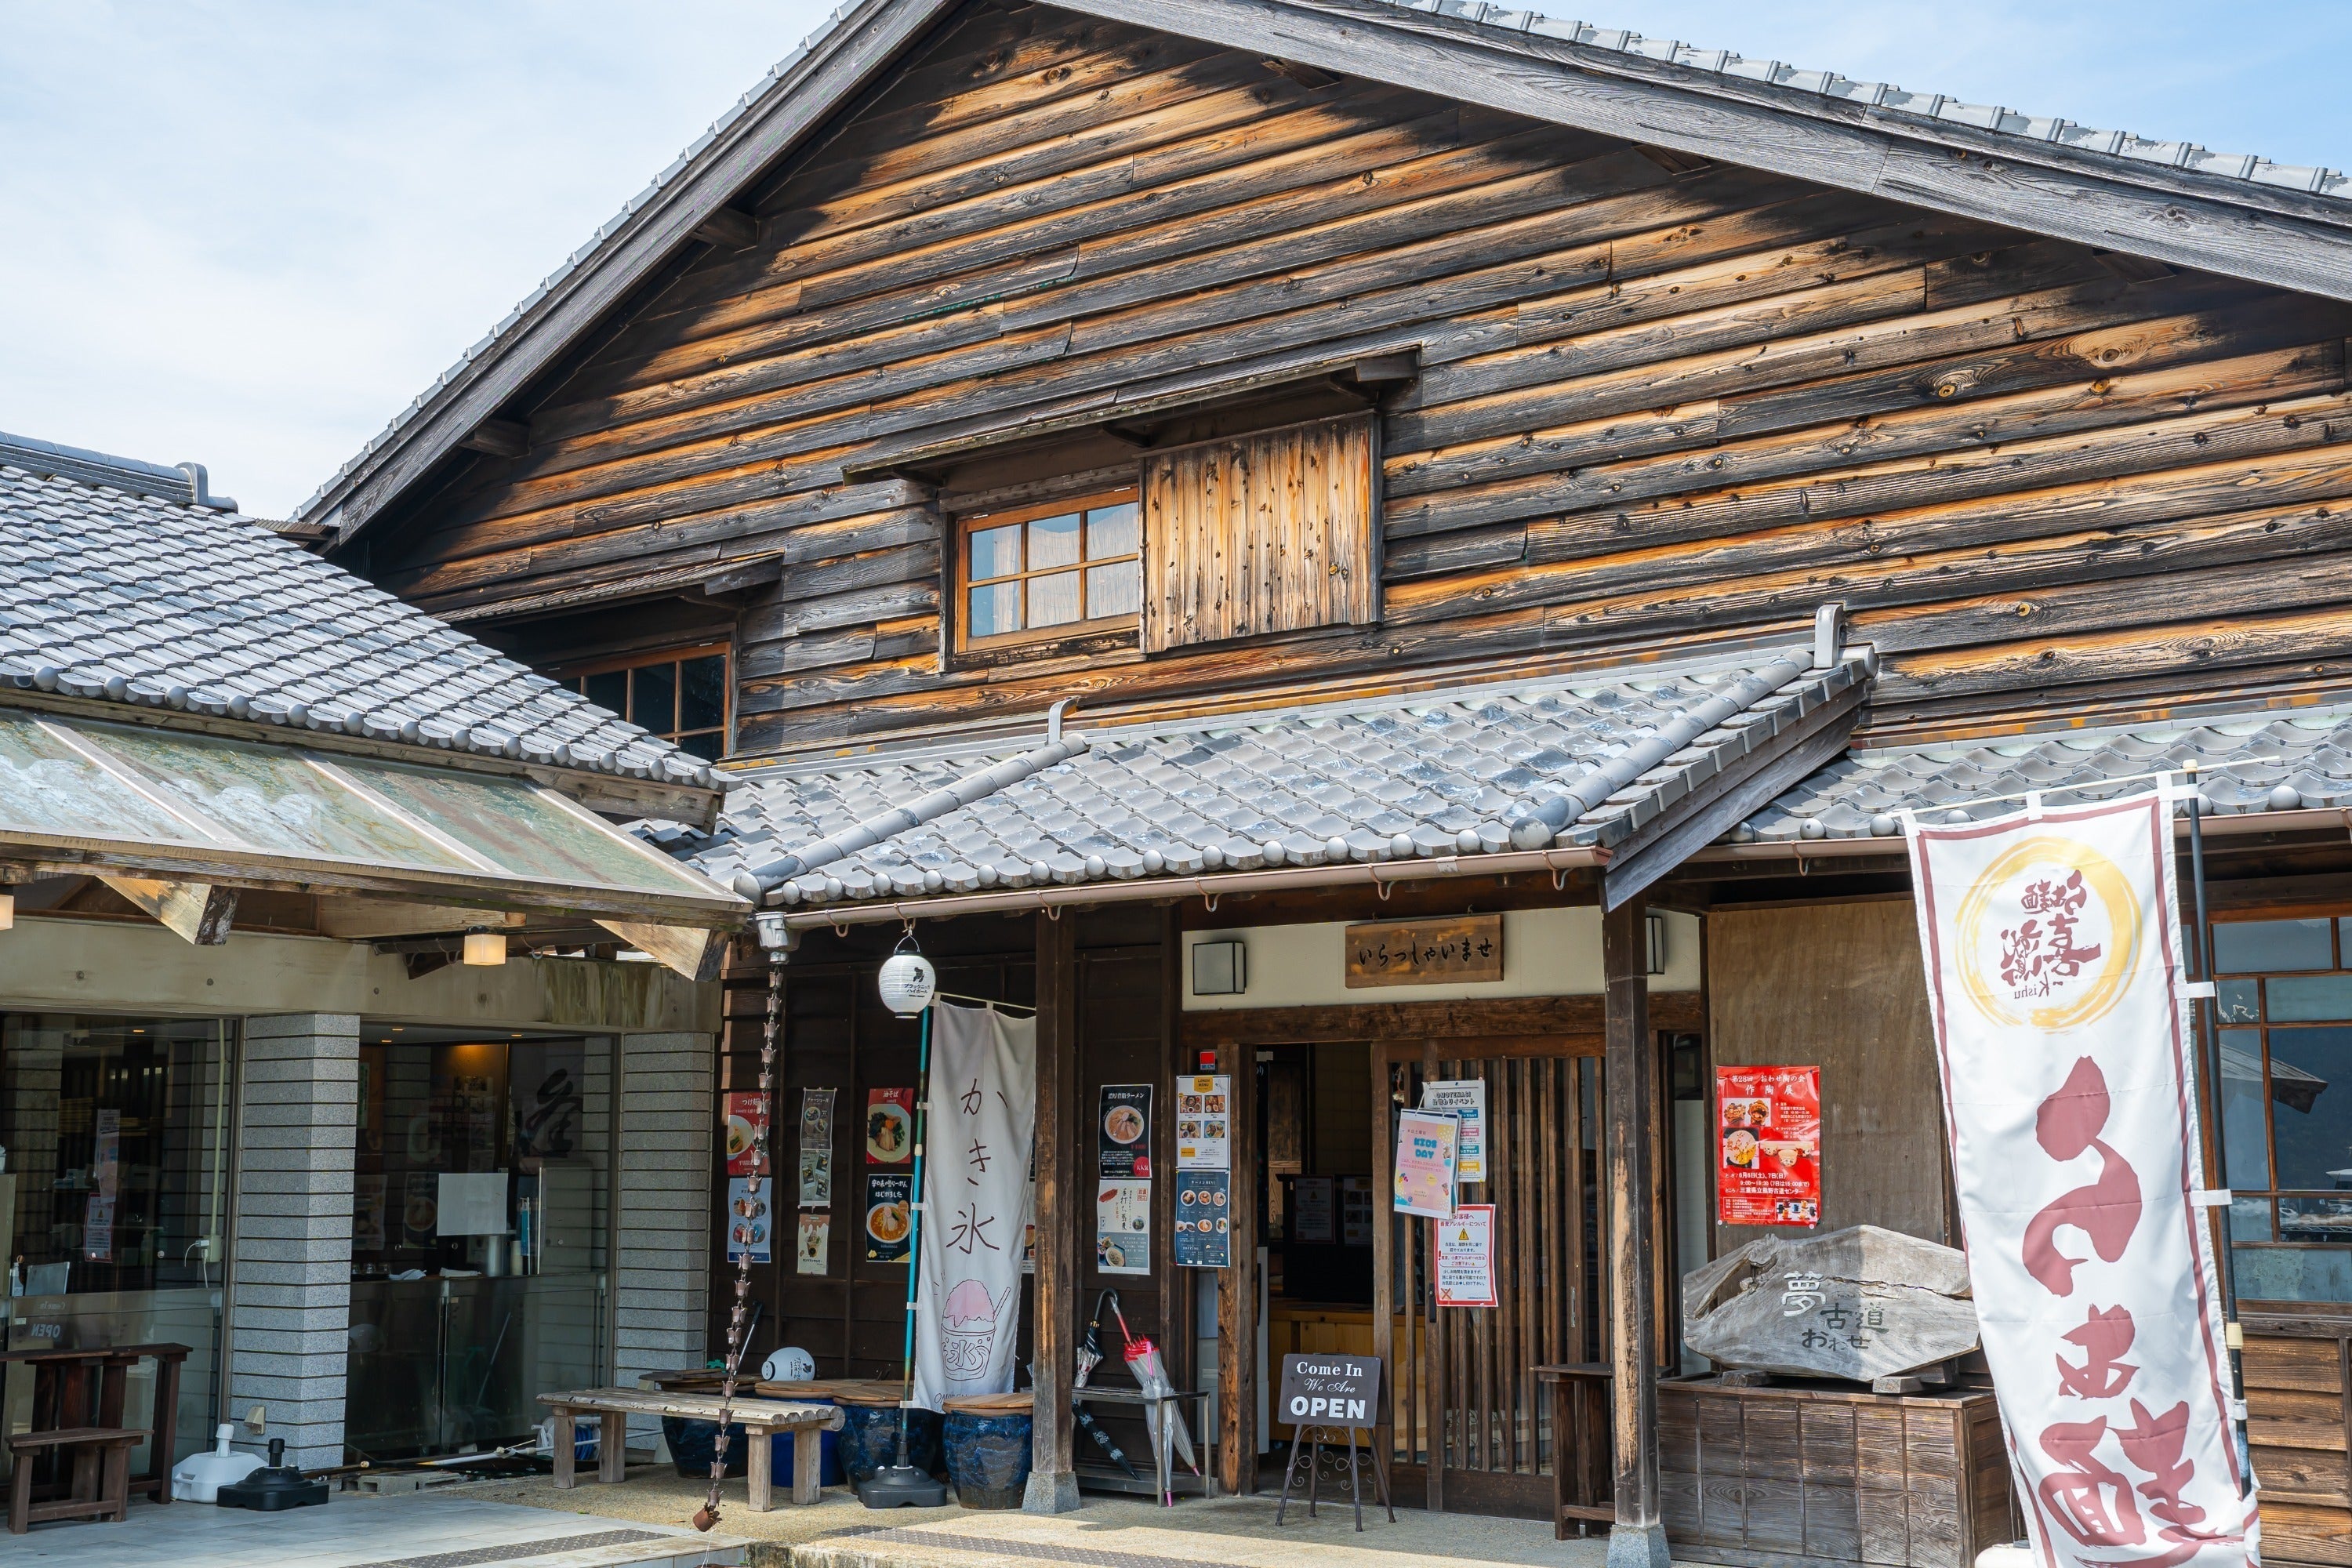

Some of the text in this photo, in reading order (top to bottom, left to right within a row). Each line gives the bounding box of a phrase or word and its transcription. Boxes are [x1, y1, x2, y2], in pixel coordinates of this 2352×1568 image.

[1359, 937, 1493, 967] いらっしゃいませ
[1745, 1084, 1795, 1095] 作陶展
[1414, 1138, 1438, 1149] KIDS
[1415, 1149, 1435, 1159] DAY
[946, 1078, 1009, 1254] かき氷
[1781, 1270, 1827, 1317] 夢
[1820, 1301, 1889, 1334] 古道
[1802, 1328, 1872, 1352] おわせ
[1296, 1361, 1363, 1377] Come In
[1304, 1378, 1356, 1393] We Are
[1290, 1396, 1366, 1419] OPEN
